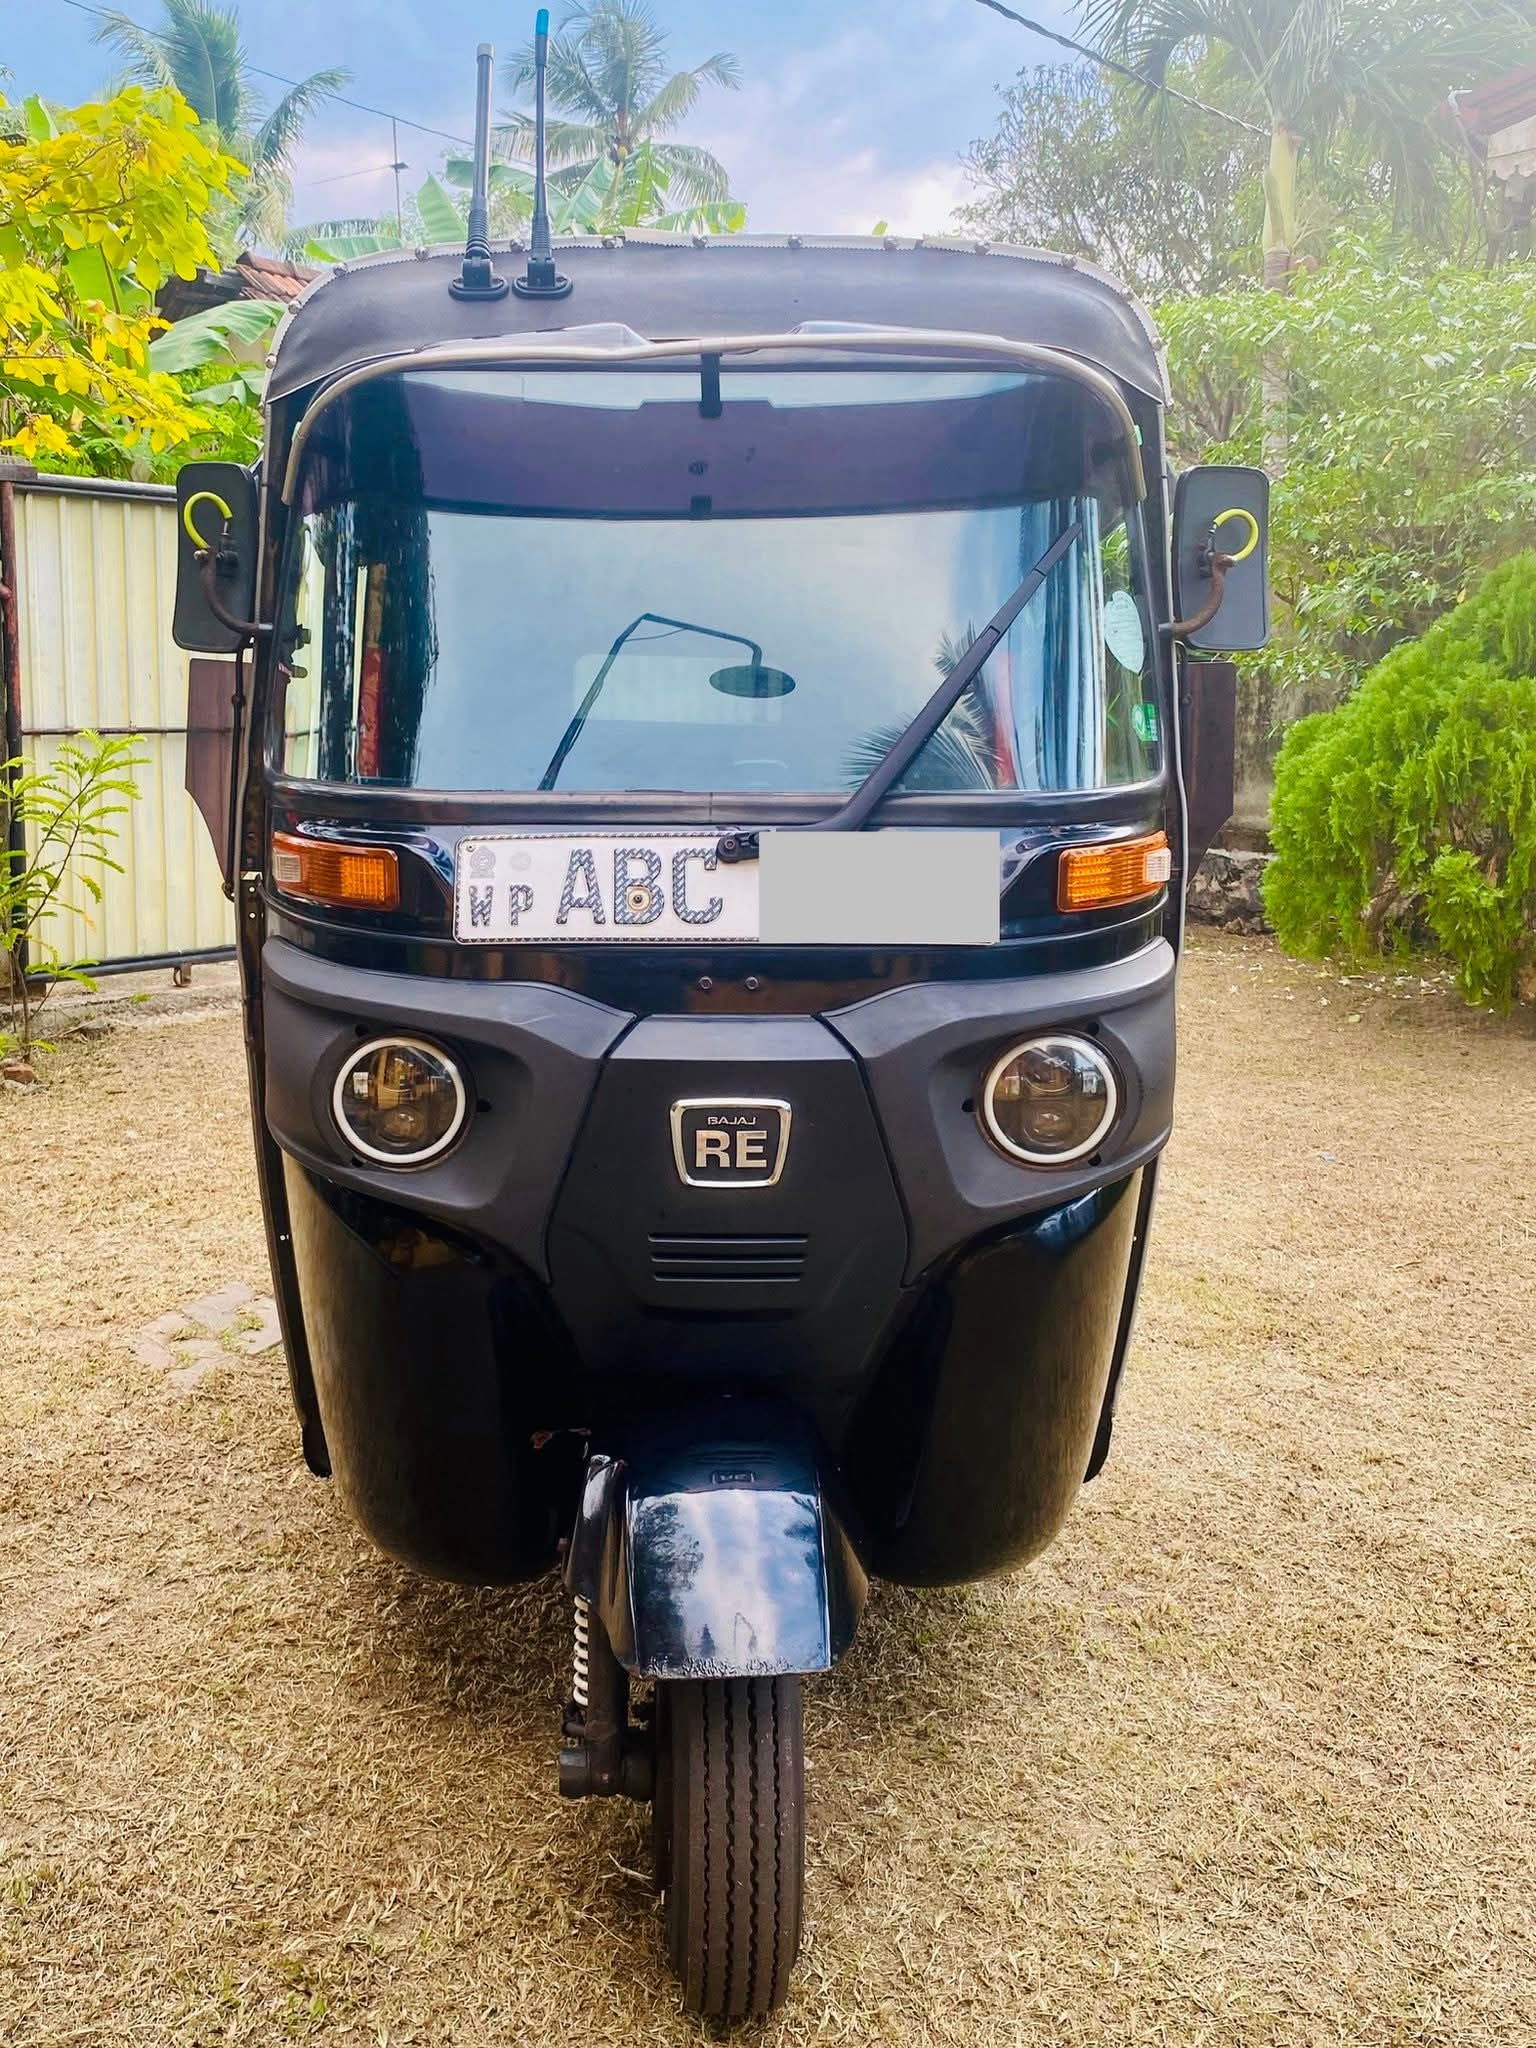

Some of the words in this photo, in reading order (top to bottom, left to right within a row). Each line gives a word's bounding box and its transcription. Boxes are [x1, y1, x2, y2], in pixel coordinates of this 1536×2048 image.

[556, 849, 723, 925] ABC
[707, 1116, 757, 1125] BAJAJ
[695, 1130, 768, 1168] RE
